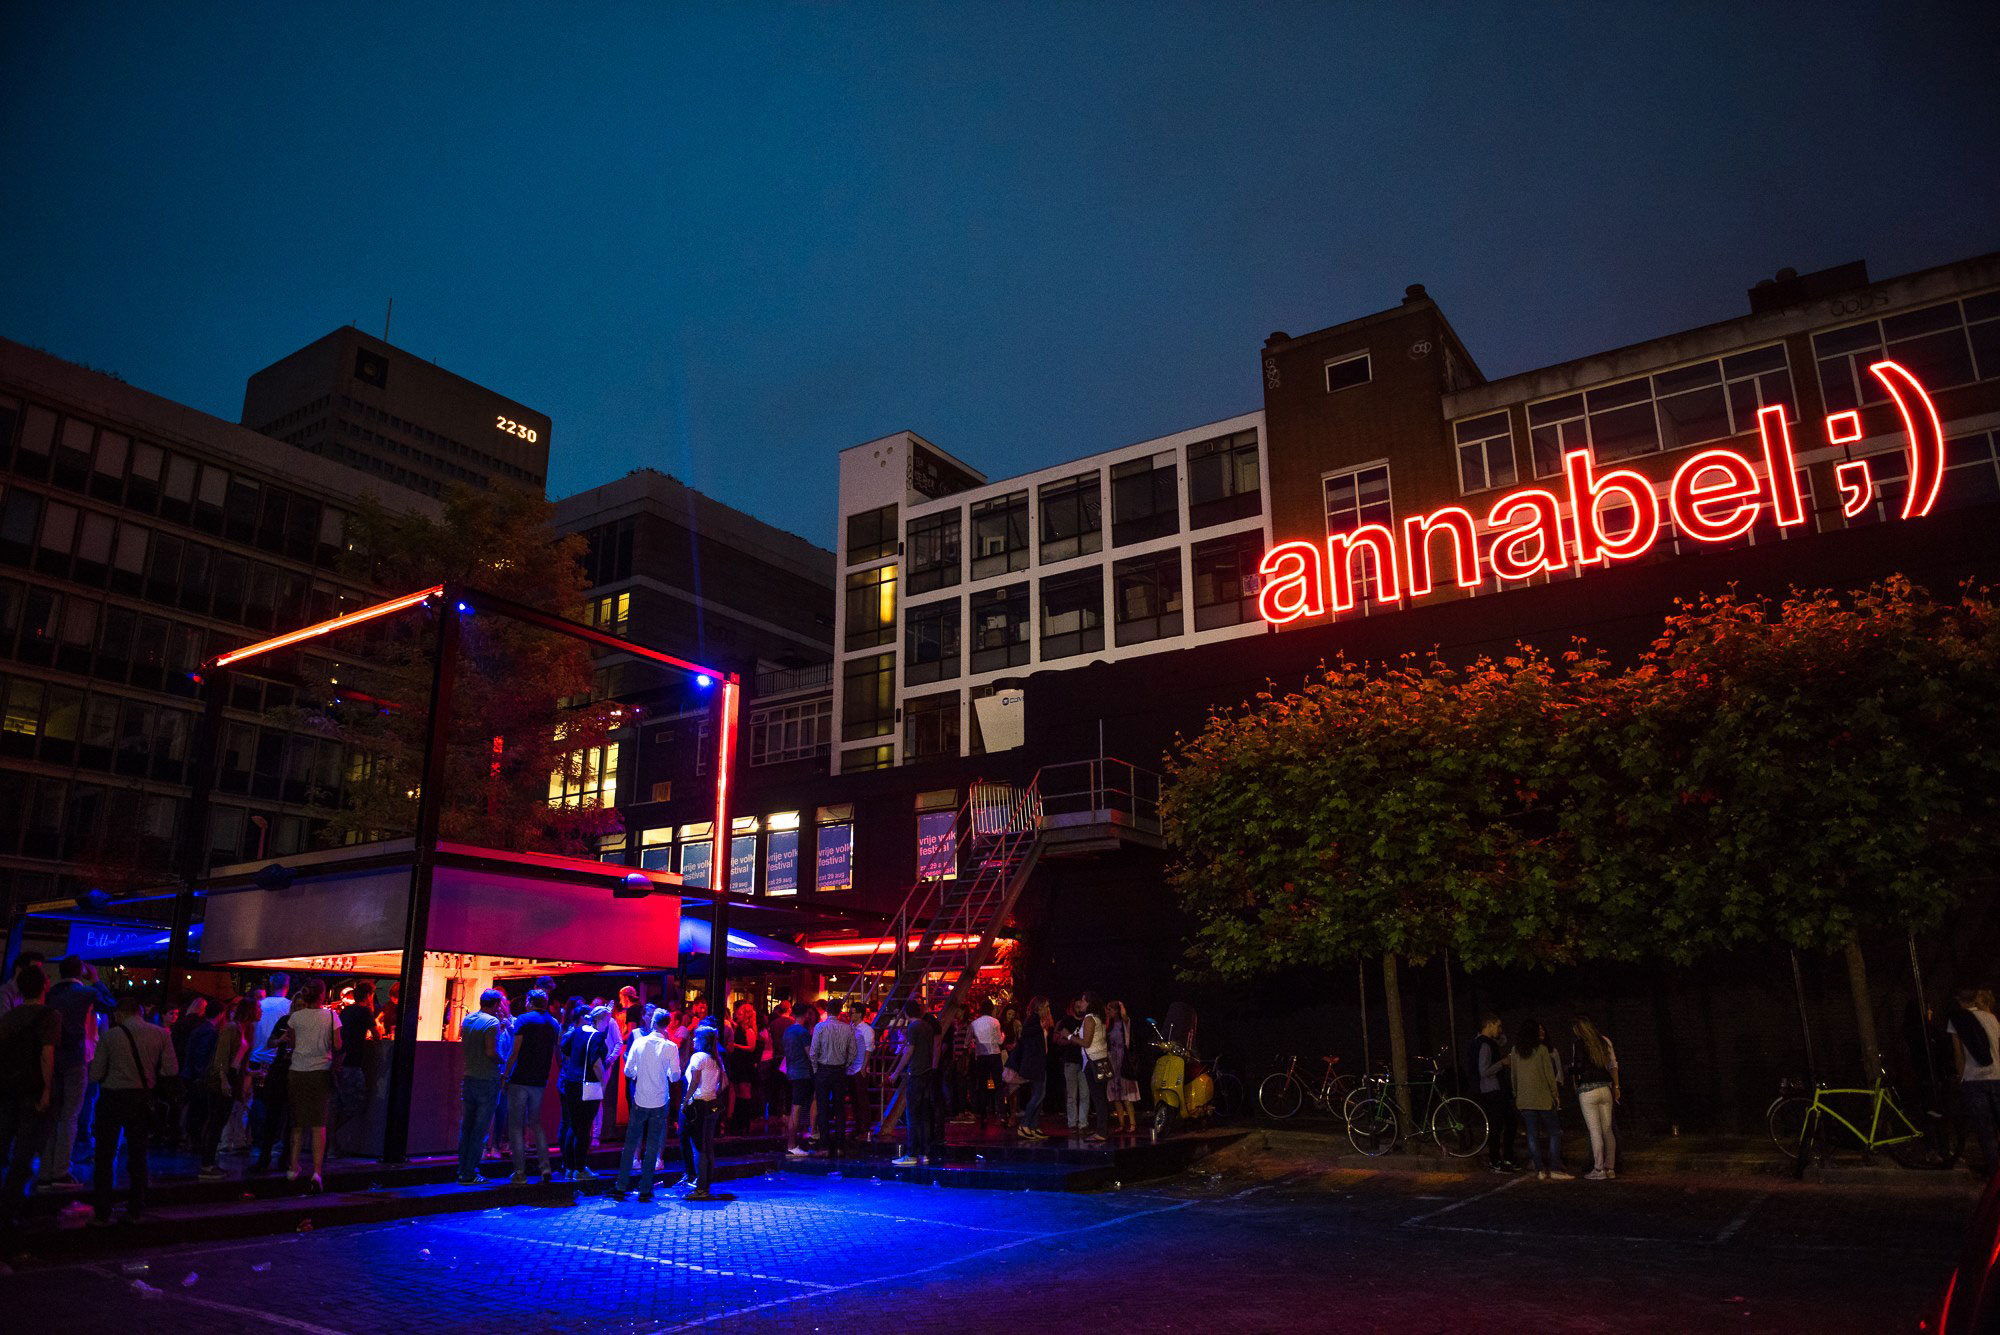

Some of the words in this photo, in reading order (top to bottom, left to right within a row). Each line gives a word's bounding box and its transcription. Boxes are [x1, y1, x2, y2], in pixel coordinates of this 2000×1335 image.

[496, 415, 537, 443] 2230
[1258, 403, 1804, 624] annabel
[920, 835, 937, 846] vrije
[819, 847, 835, 857] vrije
[920, 842, 950, 857] festial
[731, 864, 749, 875] stival
[684, 870, 706, 881] estival
